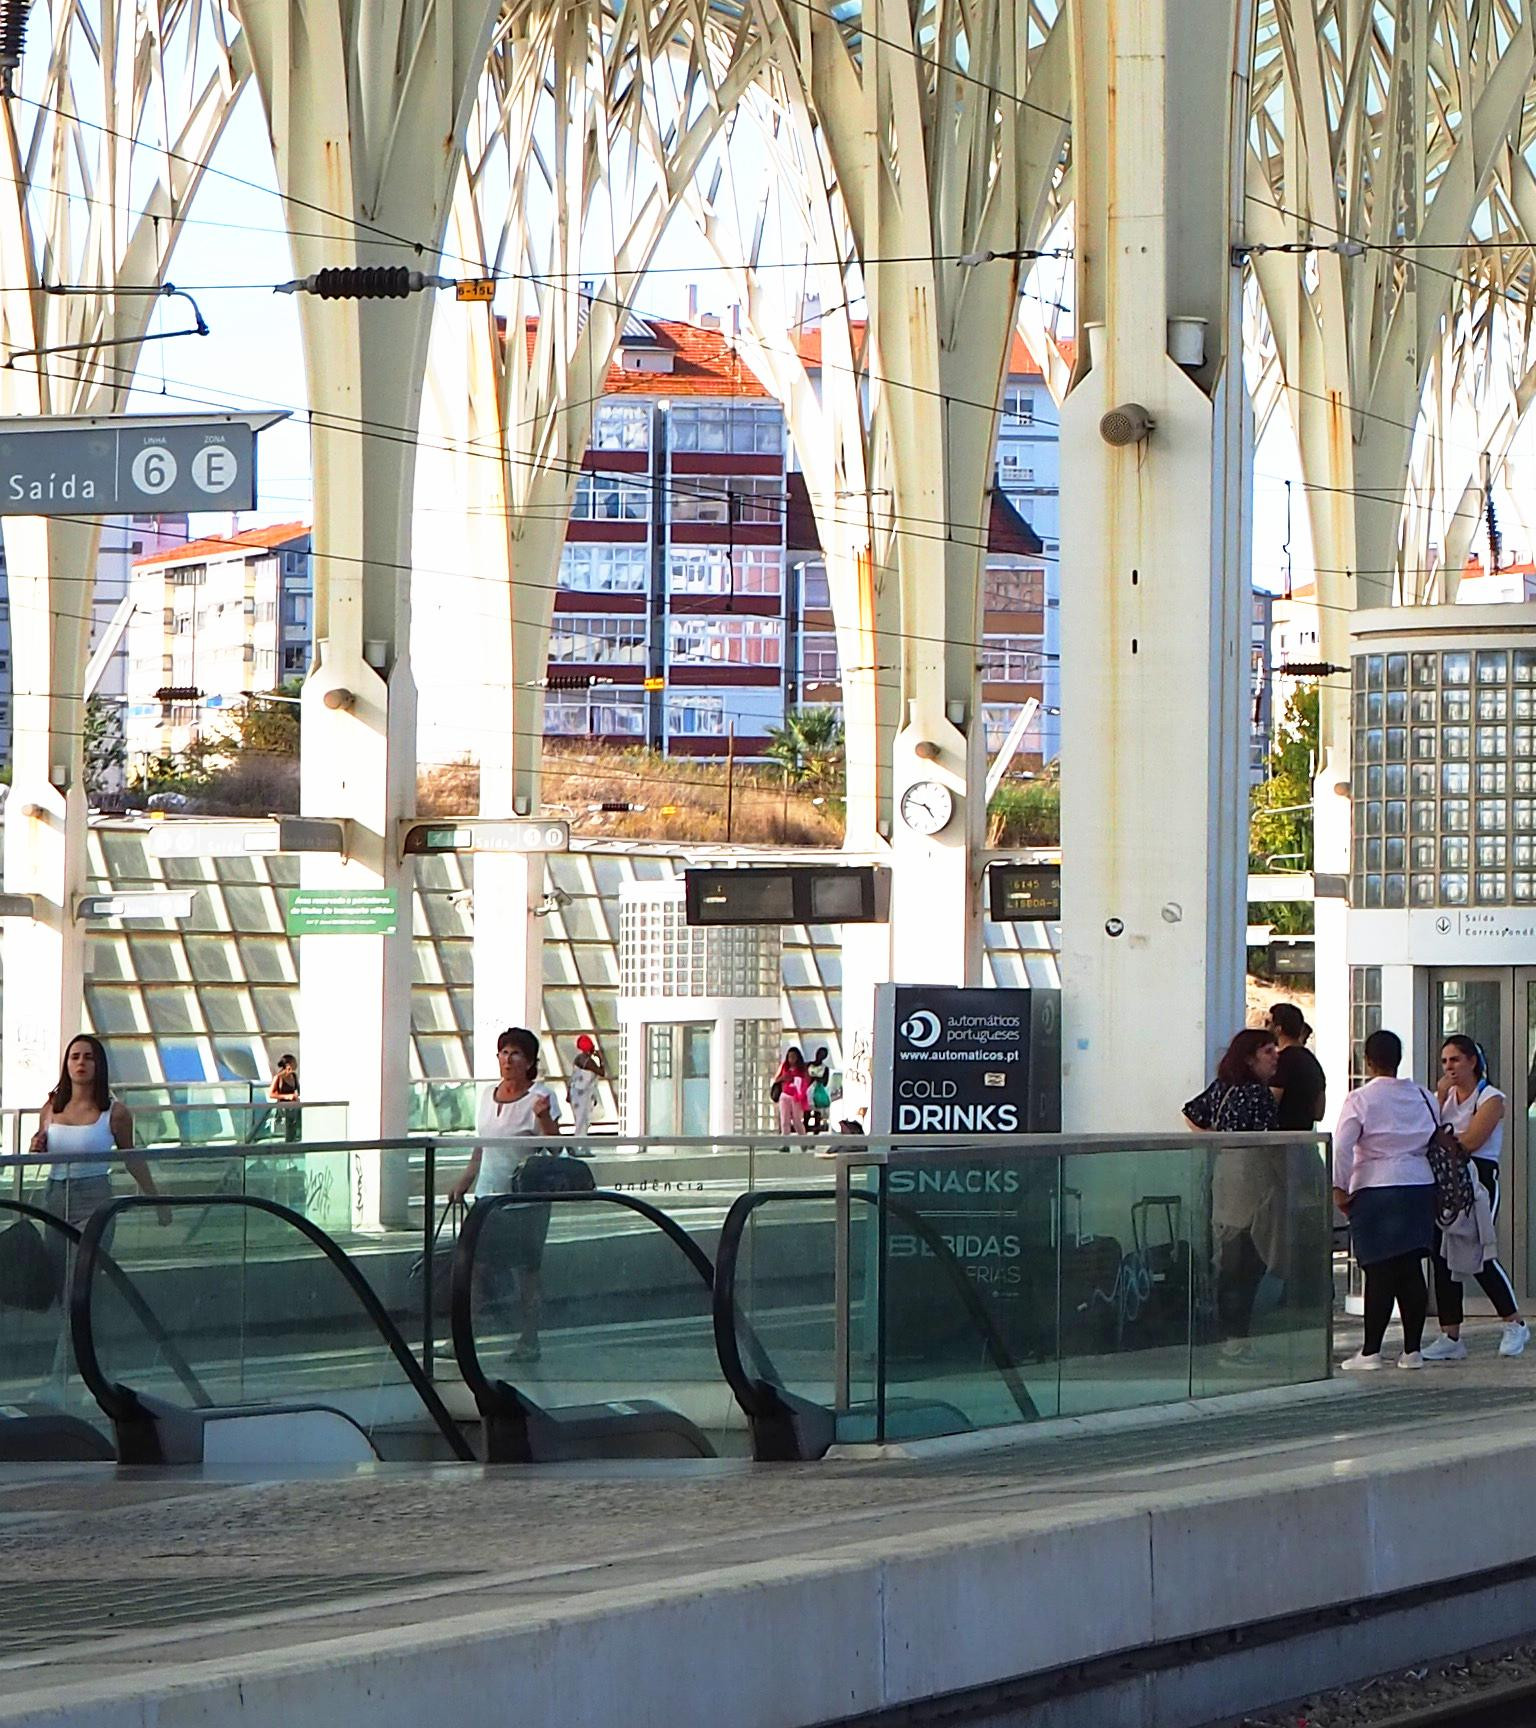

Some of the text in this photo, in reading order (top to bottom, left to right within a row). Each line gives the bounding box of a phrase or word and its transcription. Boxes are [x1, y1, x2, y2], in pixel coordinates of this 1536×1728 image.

[143, 435, 226, 445] LINHA ZONA
[9, 453, 224, 500] Saída 6 E
[948, 1015, 1020, 1027] automáticos
[947, 1030, 1020, 1043] portugueses
[900, 1049, 1019, 1063] www.automaticos.pt
[899, 1080, 957, 1099] COLD
[899, 1104, 1018, 1132] DRINKS
[888, 1170, 1019, 1193] SNACKS
